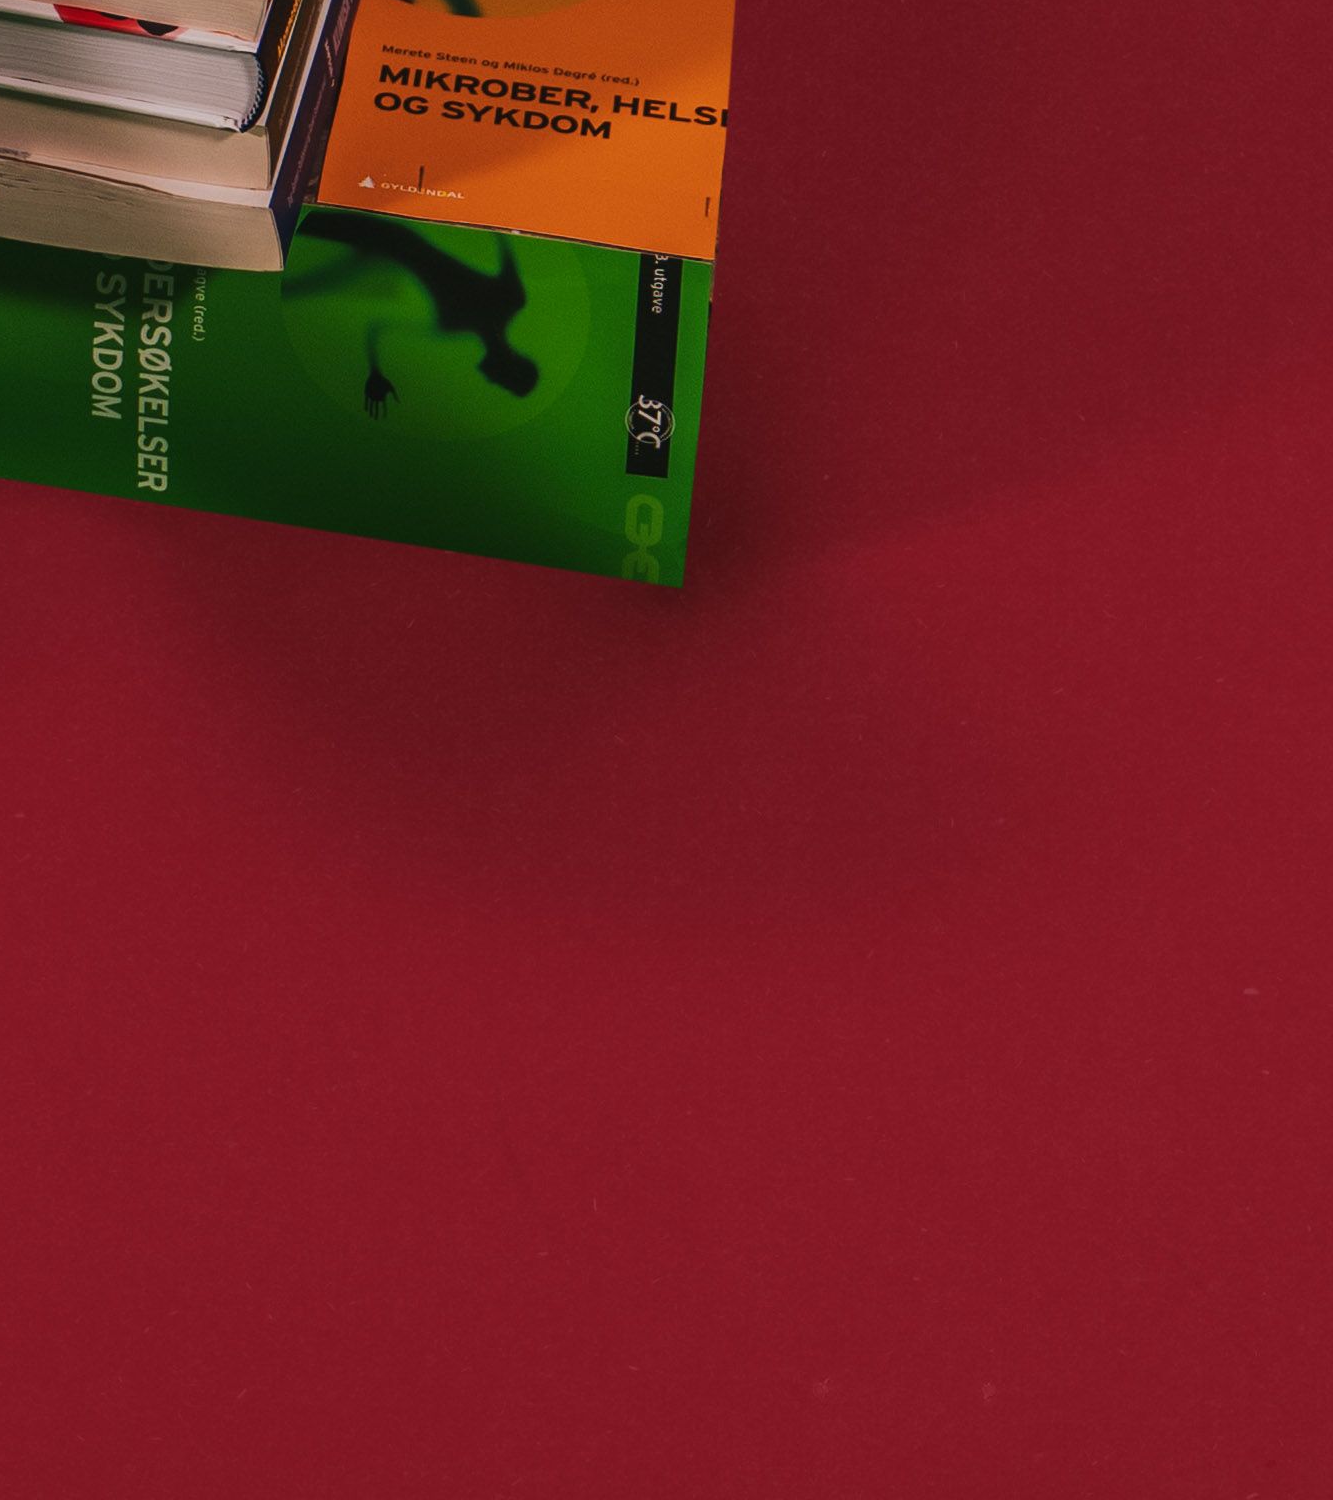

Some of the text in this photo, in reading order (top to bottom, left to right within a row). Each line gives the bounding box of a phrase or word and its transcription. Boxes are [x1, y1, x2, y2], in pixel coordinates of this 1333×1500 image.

[378, 63, 599, 113] MIKROBER,
[380, 43, 641, 89] Merete Steen Miklos Degré (red.)
[373, 91, 612, 140] OG SYKDOM
[649, 267, 667, 315] utgave
[91, 271, 128, 420] SYKDOM
[637, 394, 663, 450] 37°C
